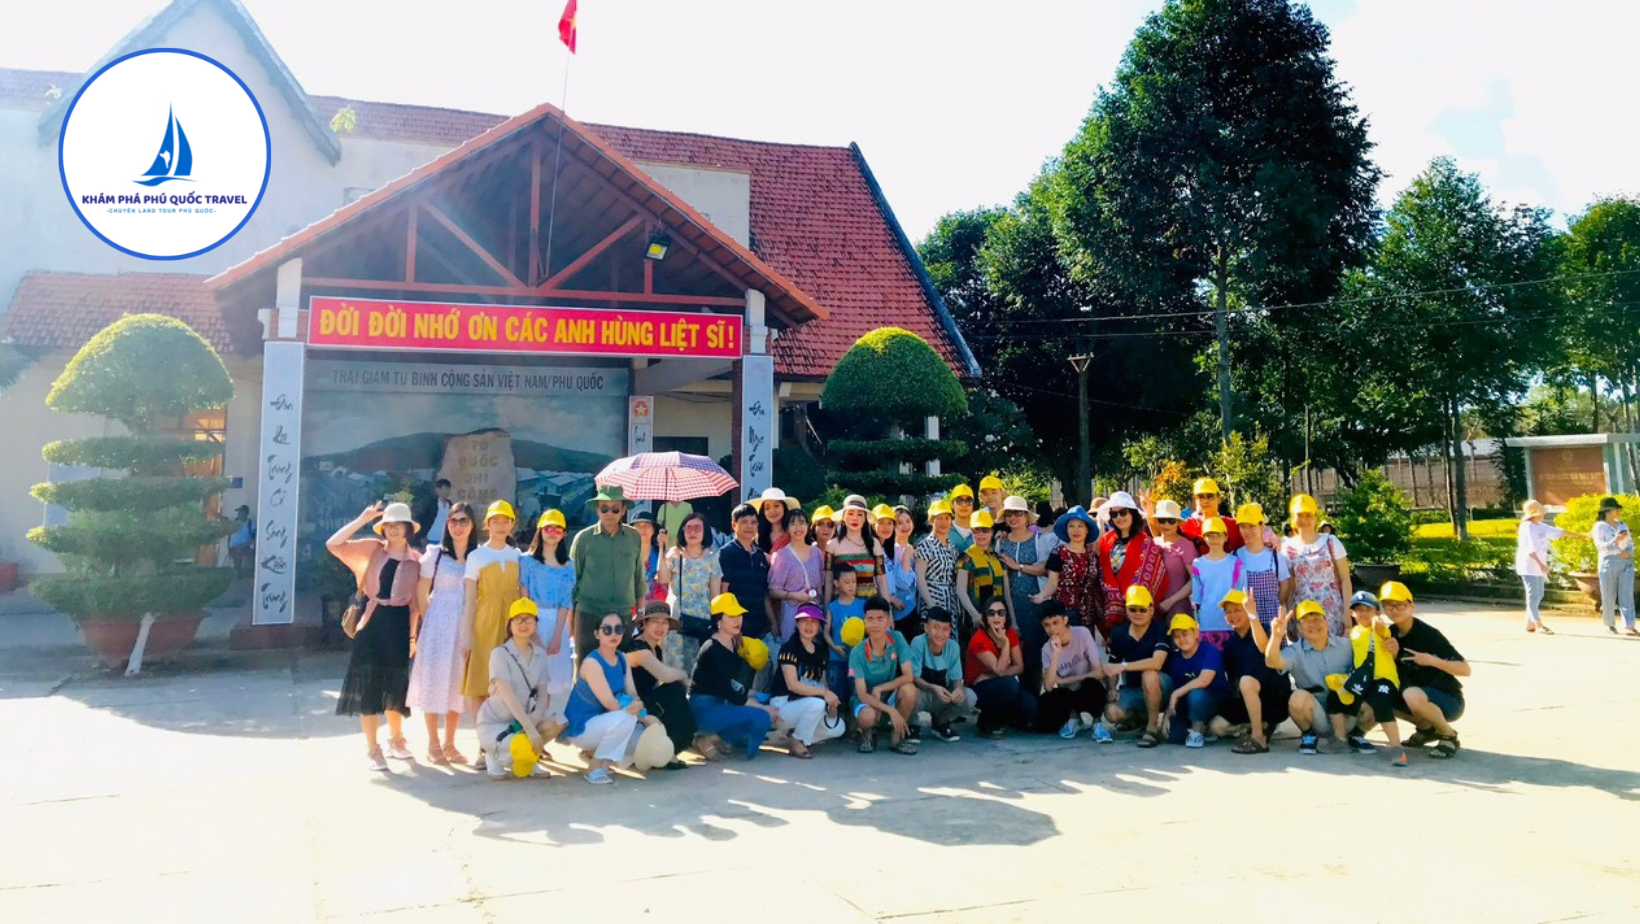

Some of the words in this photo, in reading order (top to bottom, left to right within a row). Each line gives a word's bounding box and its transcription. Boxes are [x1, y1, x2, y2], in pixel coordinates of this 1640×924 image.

[319, 302, 360, 336] ĐỜI
[368, 304, 407, 339] ĐỜI
[414, 307, 461, 340] NHỚ
[468, 311, 498, 341] ƠN
[505, 311, 548, 343] CÁC
[554, 318, 595, 344] ANH
[601, 315, 654, 346] HÙNG
[659, 318, 700, 351] LIỆT
[362, 370, 390, 385] GIAM
[441, 369, 470, 389] CỘNG
[473, 368, 494, 388] SẢN
[497, 371, 520, 391] VIỆT
[576, 370, 604, 391] QUỐC
